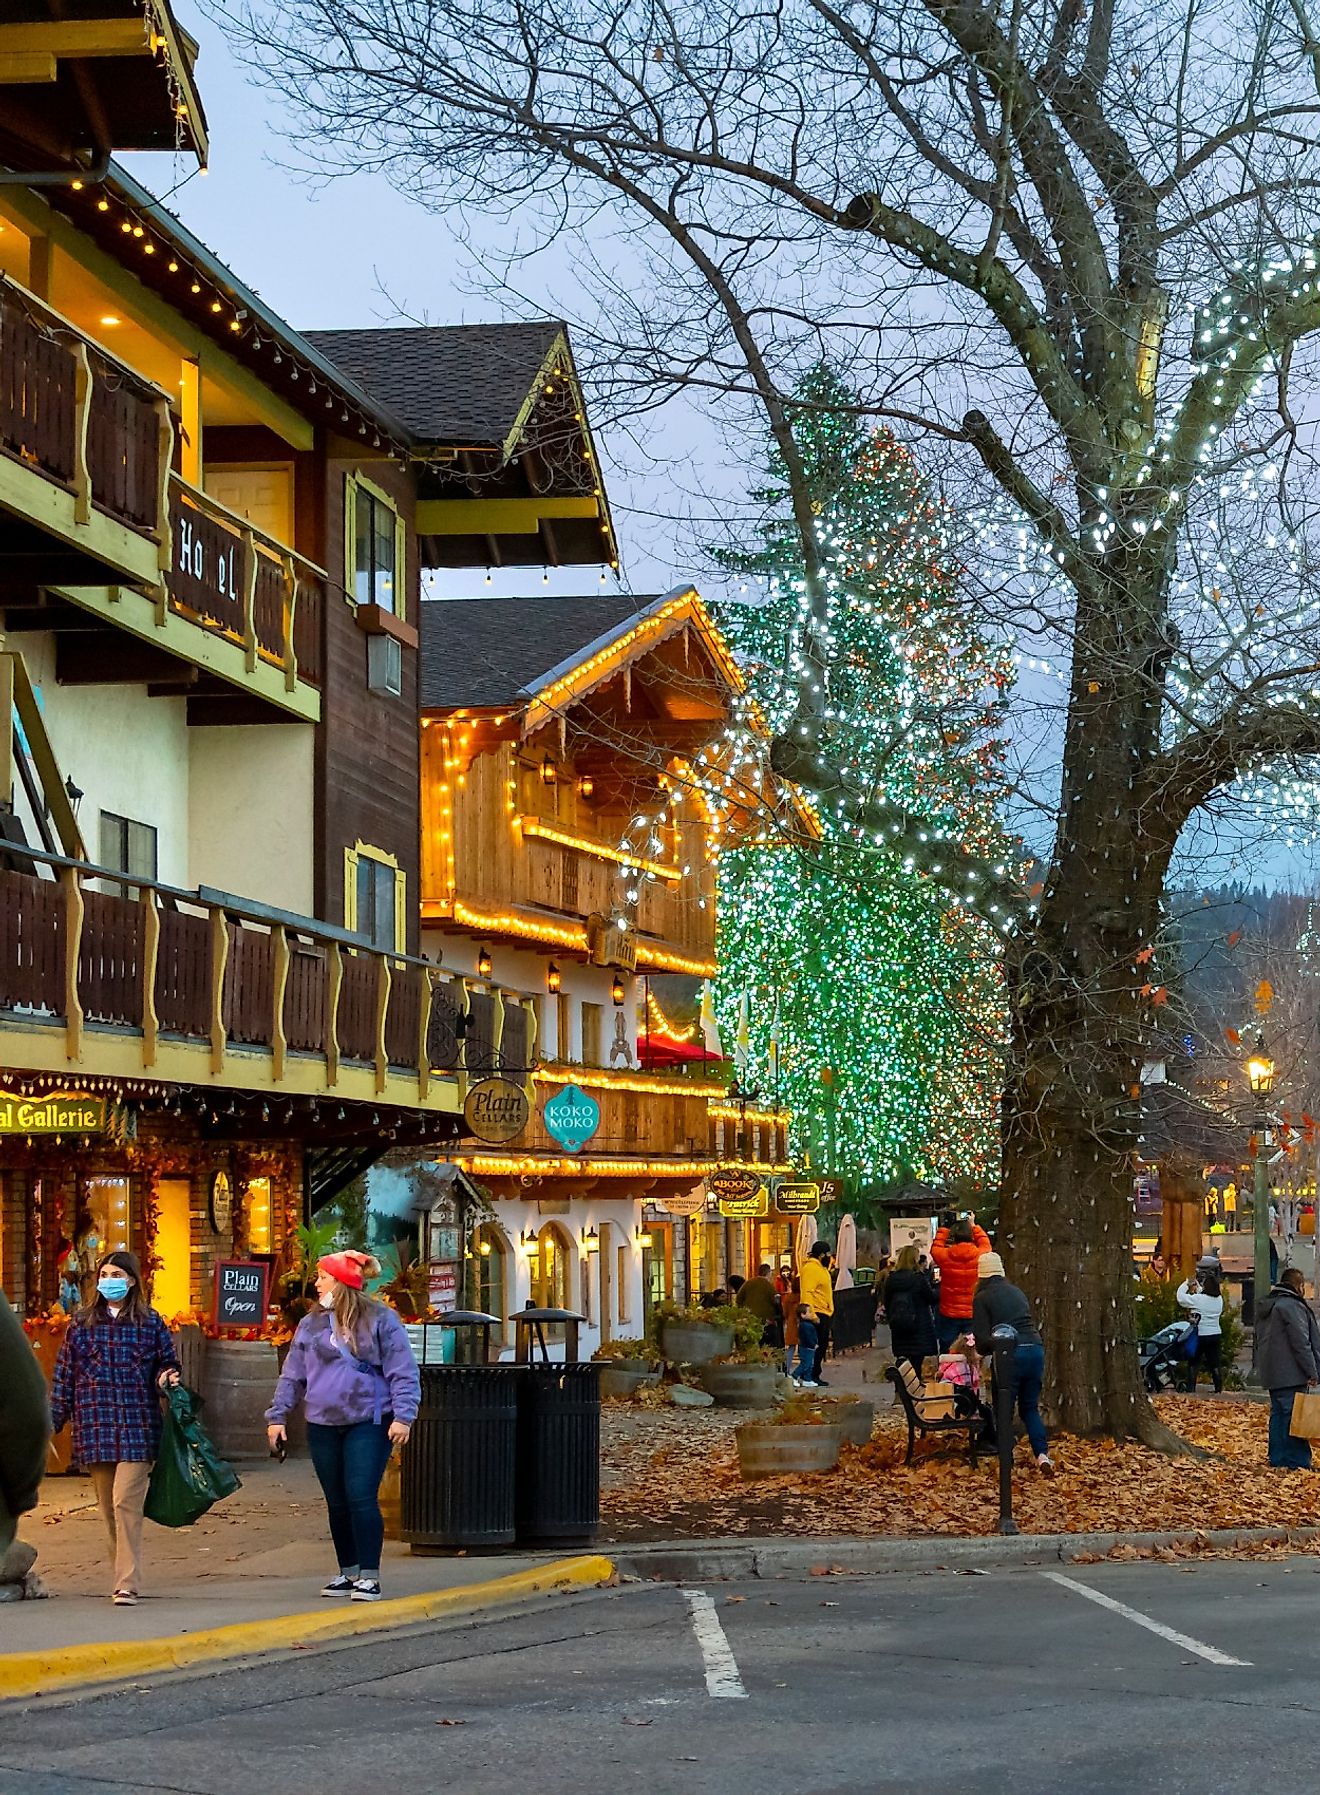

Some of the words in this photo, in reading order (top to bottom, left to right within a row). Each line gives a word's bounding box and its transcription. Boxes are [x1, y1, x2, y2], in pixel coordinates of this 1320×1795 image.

[472, 1089, 521, 1112] Plain
[18, 1104, 97, 1128] Gallerie
[550, 1106, 593, 1117] KOKO
[550, 1117, 594, 1128] MOKO
[720, 1180, 753, 1190] BOOK
[224, 1270, 259, 1287] Plain
[224, 1283, 258, 1292] CELLARS
[224, 1296, 256, 1315] Open
